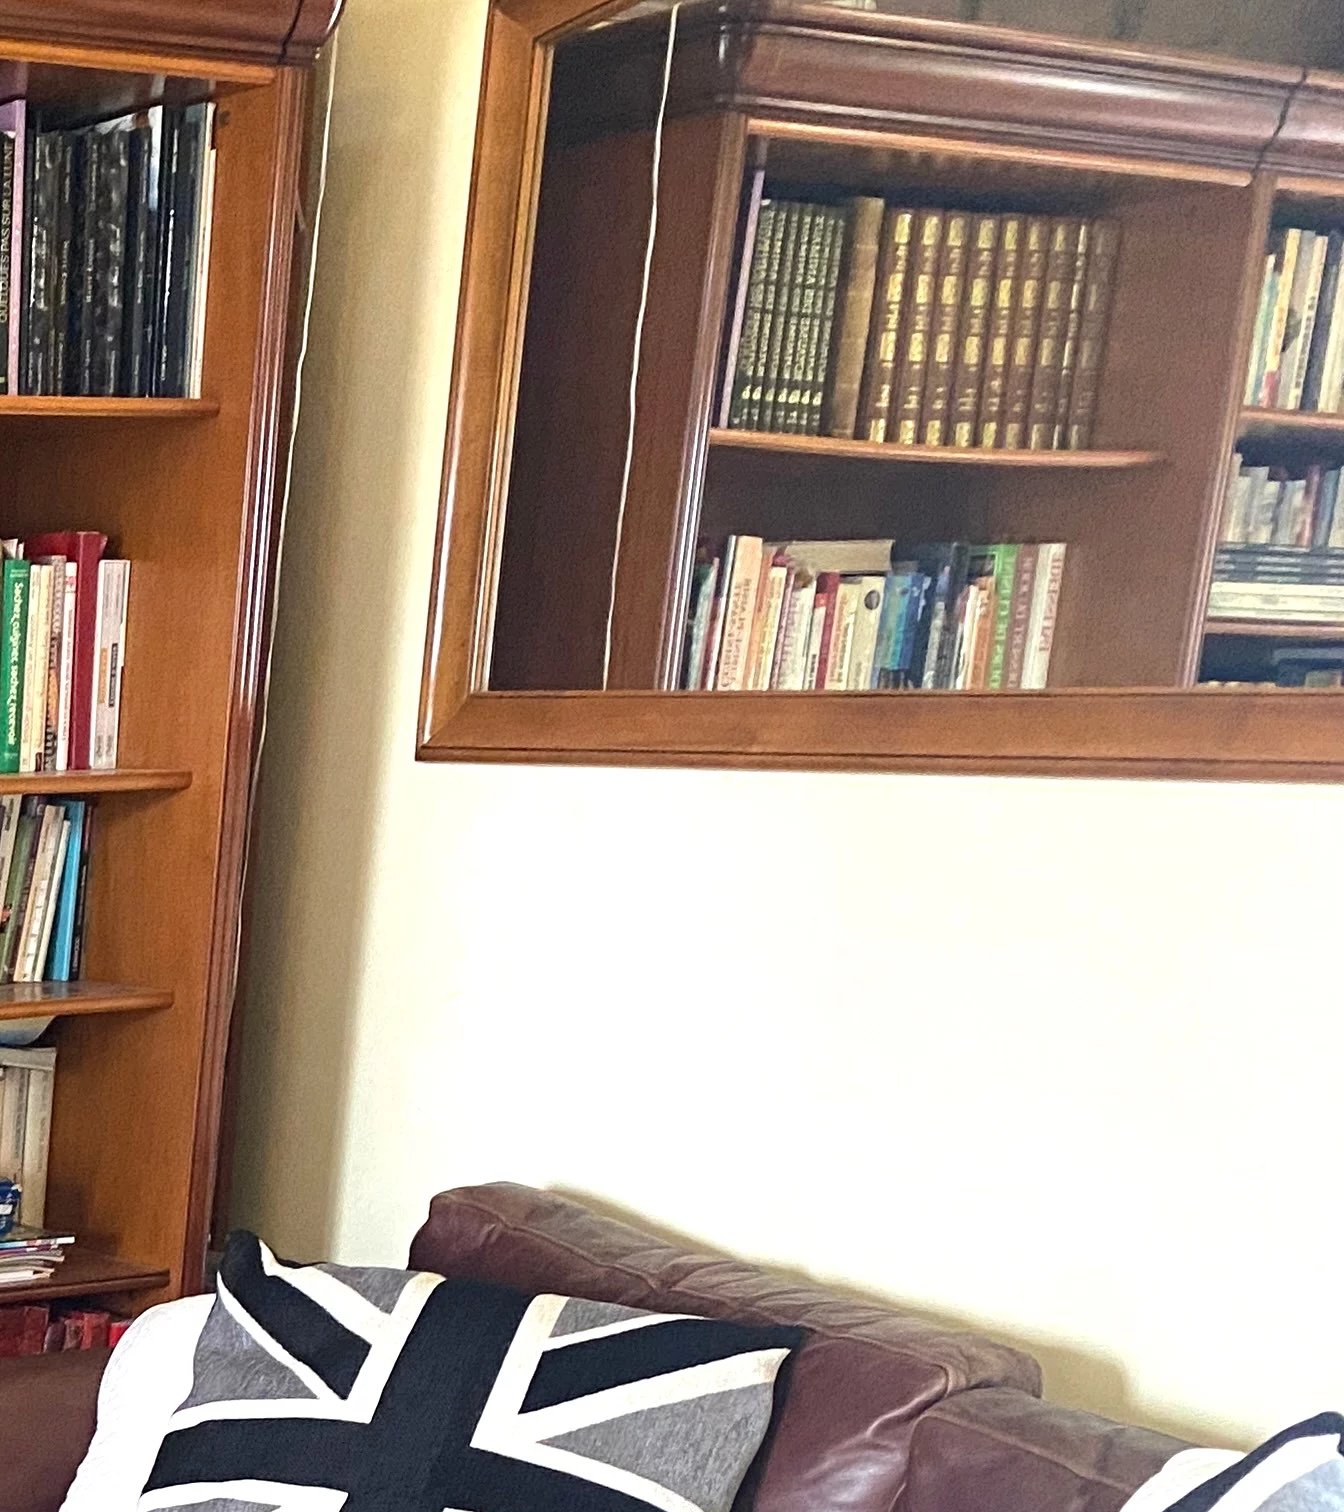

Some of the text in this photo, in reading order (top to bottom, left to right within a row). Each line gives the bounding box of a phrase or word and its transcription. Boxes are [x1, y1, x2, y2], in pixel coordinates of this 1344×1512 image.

[2, 142, 13, 177] LUNE
[1, 179, 12, 198] LA
[1, 199, 11, 225] SUR
[0, 228, 11, 252] PAS
